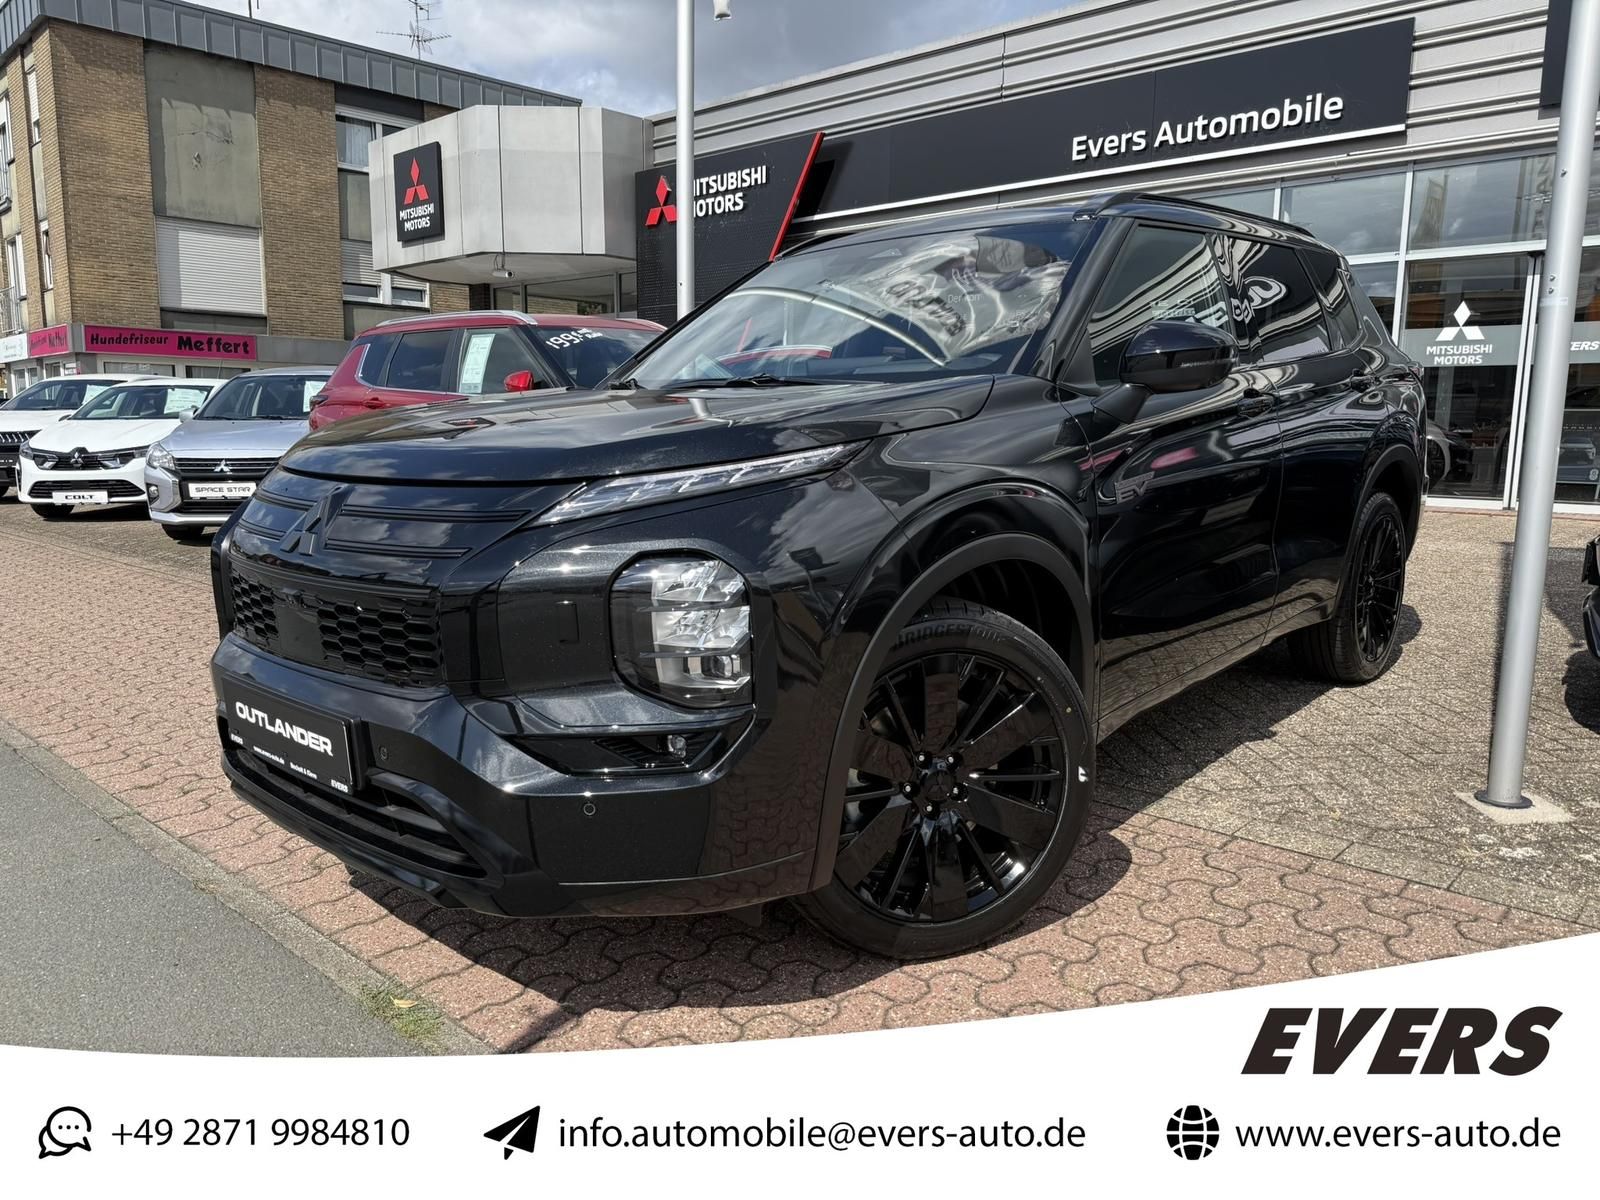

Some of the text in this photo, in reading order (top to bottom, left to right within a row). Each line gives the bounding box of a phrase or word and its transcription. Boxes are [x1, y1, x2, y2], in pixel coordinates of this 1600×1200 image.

[1071, 93, 1344, 161] Evers Automobile
[694, 165, 767, 196] ITSUBISHI
[400, 203, 435, 220] MITSUBISHI
[694, 192, 744, 218] OTORS
[404, 216, 431, 231] MOTORS
[90, 333, 250, 354] Hundefriseur Meffert
[1425, 344, 1493, 356] MITSUBISHI
[1570, 341, 1600, 351] ERS
[1433, 355, 1483, 365] MOTORS
[235, 701, 334, 757] OUTLANDER
